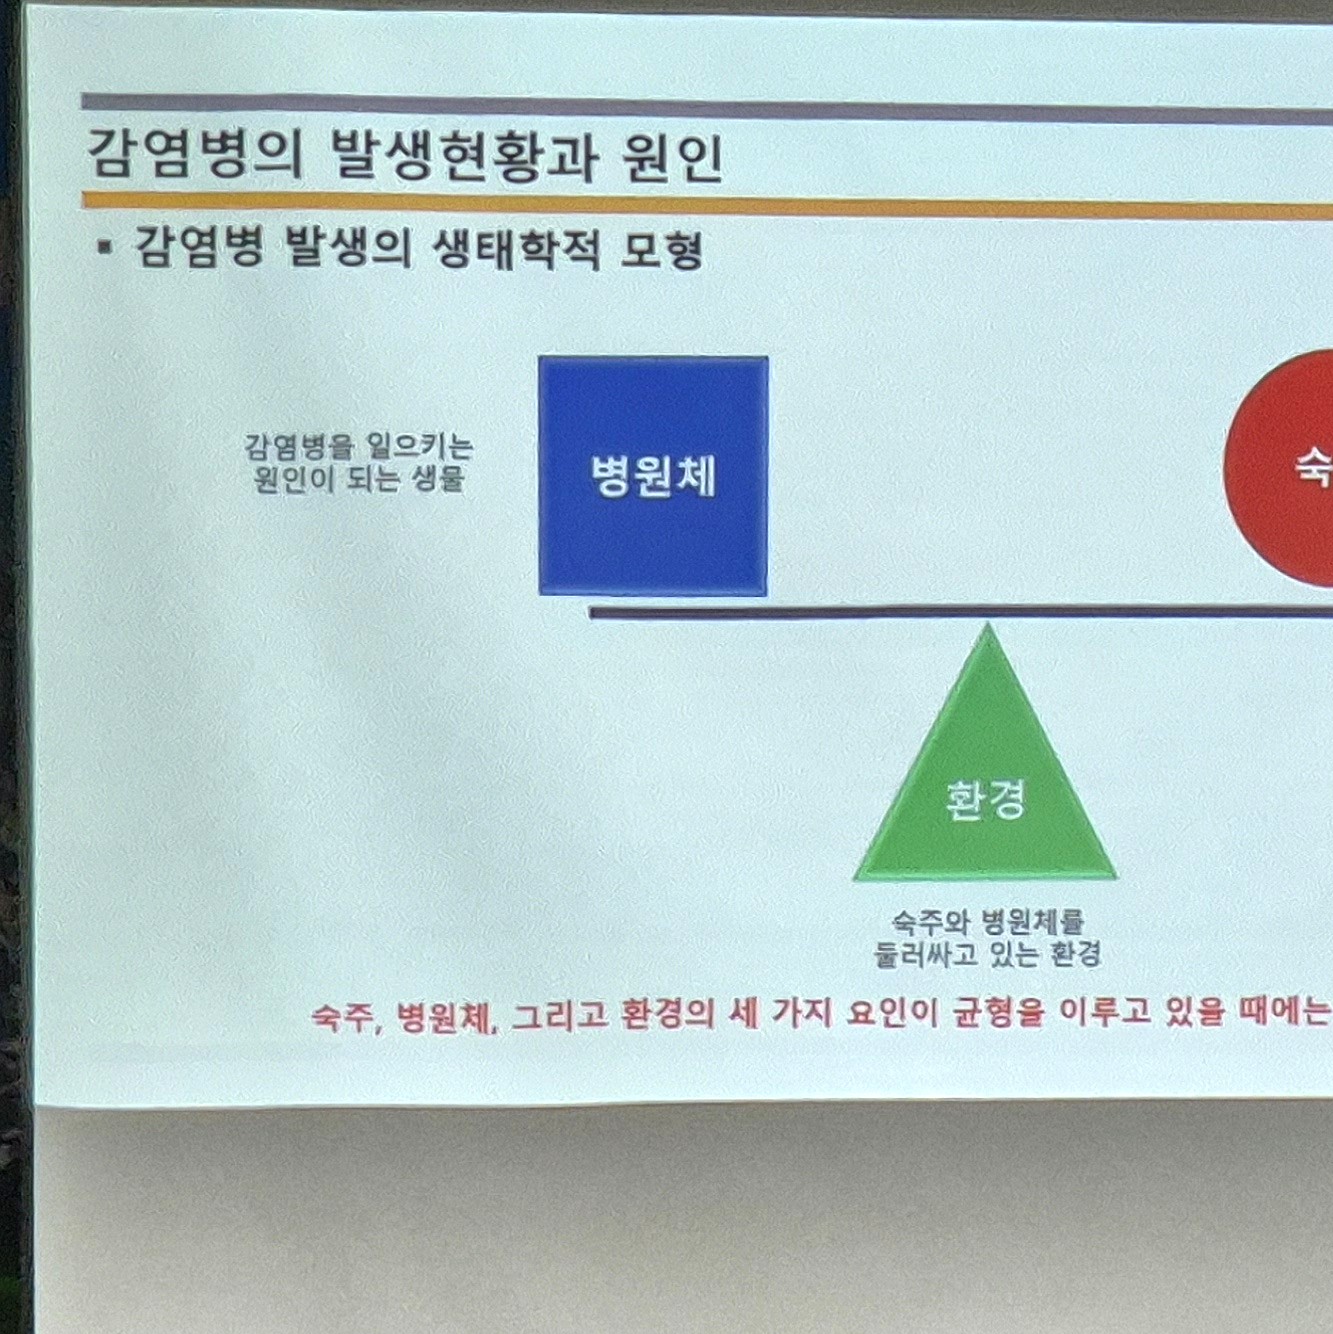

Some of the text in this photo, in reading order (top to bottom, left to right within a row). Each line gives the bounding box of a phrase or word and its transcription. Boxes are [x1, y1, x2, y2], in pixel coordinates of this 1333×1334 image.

[88, 126, 723, 185] 감염병의 발생현황과 원인
[135, 224, 704, 272] 감염병 발생의 생태학적 모형
[244, 432, 474, 462] 감염병을 일으키는
[254, 464, 466, 495] 원인이 되는 생물
[591, 454, 717, 498] 병원체
[945, 778, 1027, 823] 환경
[891, 908, 1085, 938] 숙주와 병원체를
[873, 939, 1103, 970] 둘러싸고 있는 환경
[311, 1003, 383, 1036] 숙주,
[396, 1003, 498, 1036] 병원체,
[512, 1001, 608, 1032] 그리고
[622, 997, 716, 1031] 환경의
[729, 996, 761, 1031] 세
[772, 996, 833, 1029] 가지
[846, 996, 939, 1030] 요인이
[952, 996, 1046, 1030] 균형을
[1060, 996, 1153, 1029] 이루고
[1167, 995, 1226, 1029] 있을
[1239, 995, 1333, 1028] 때에는
